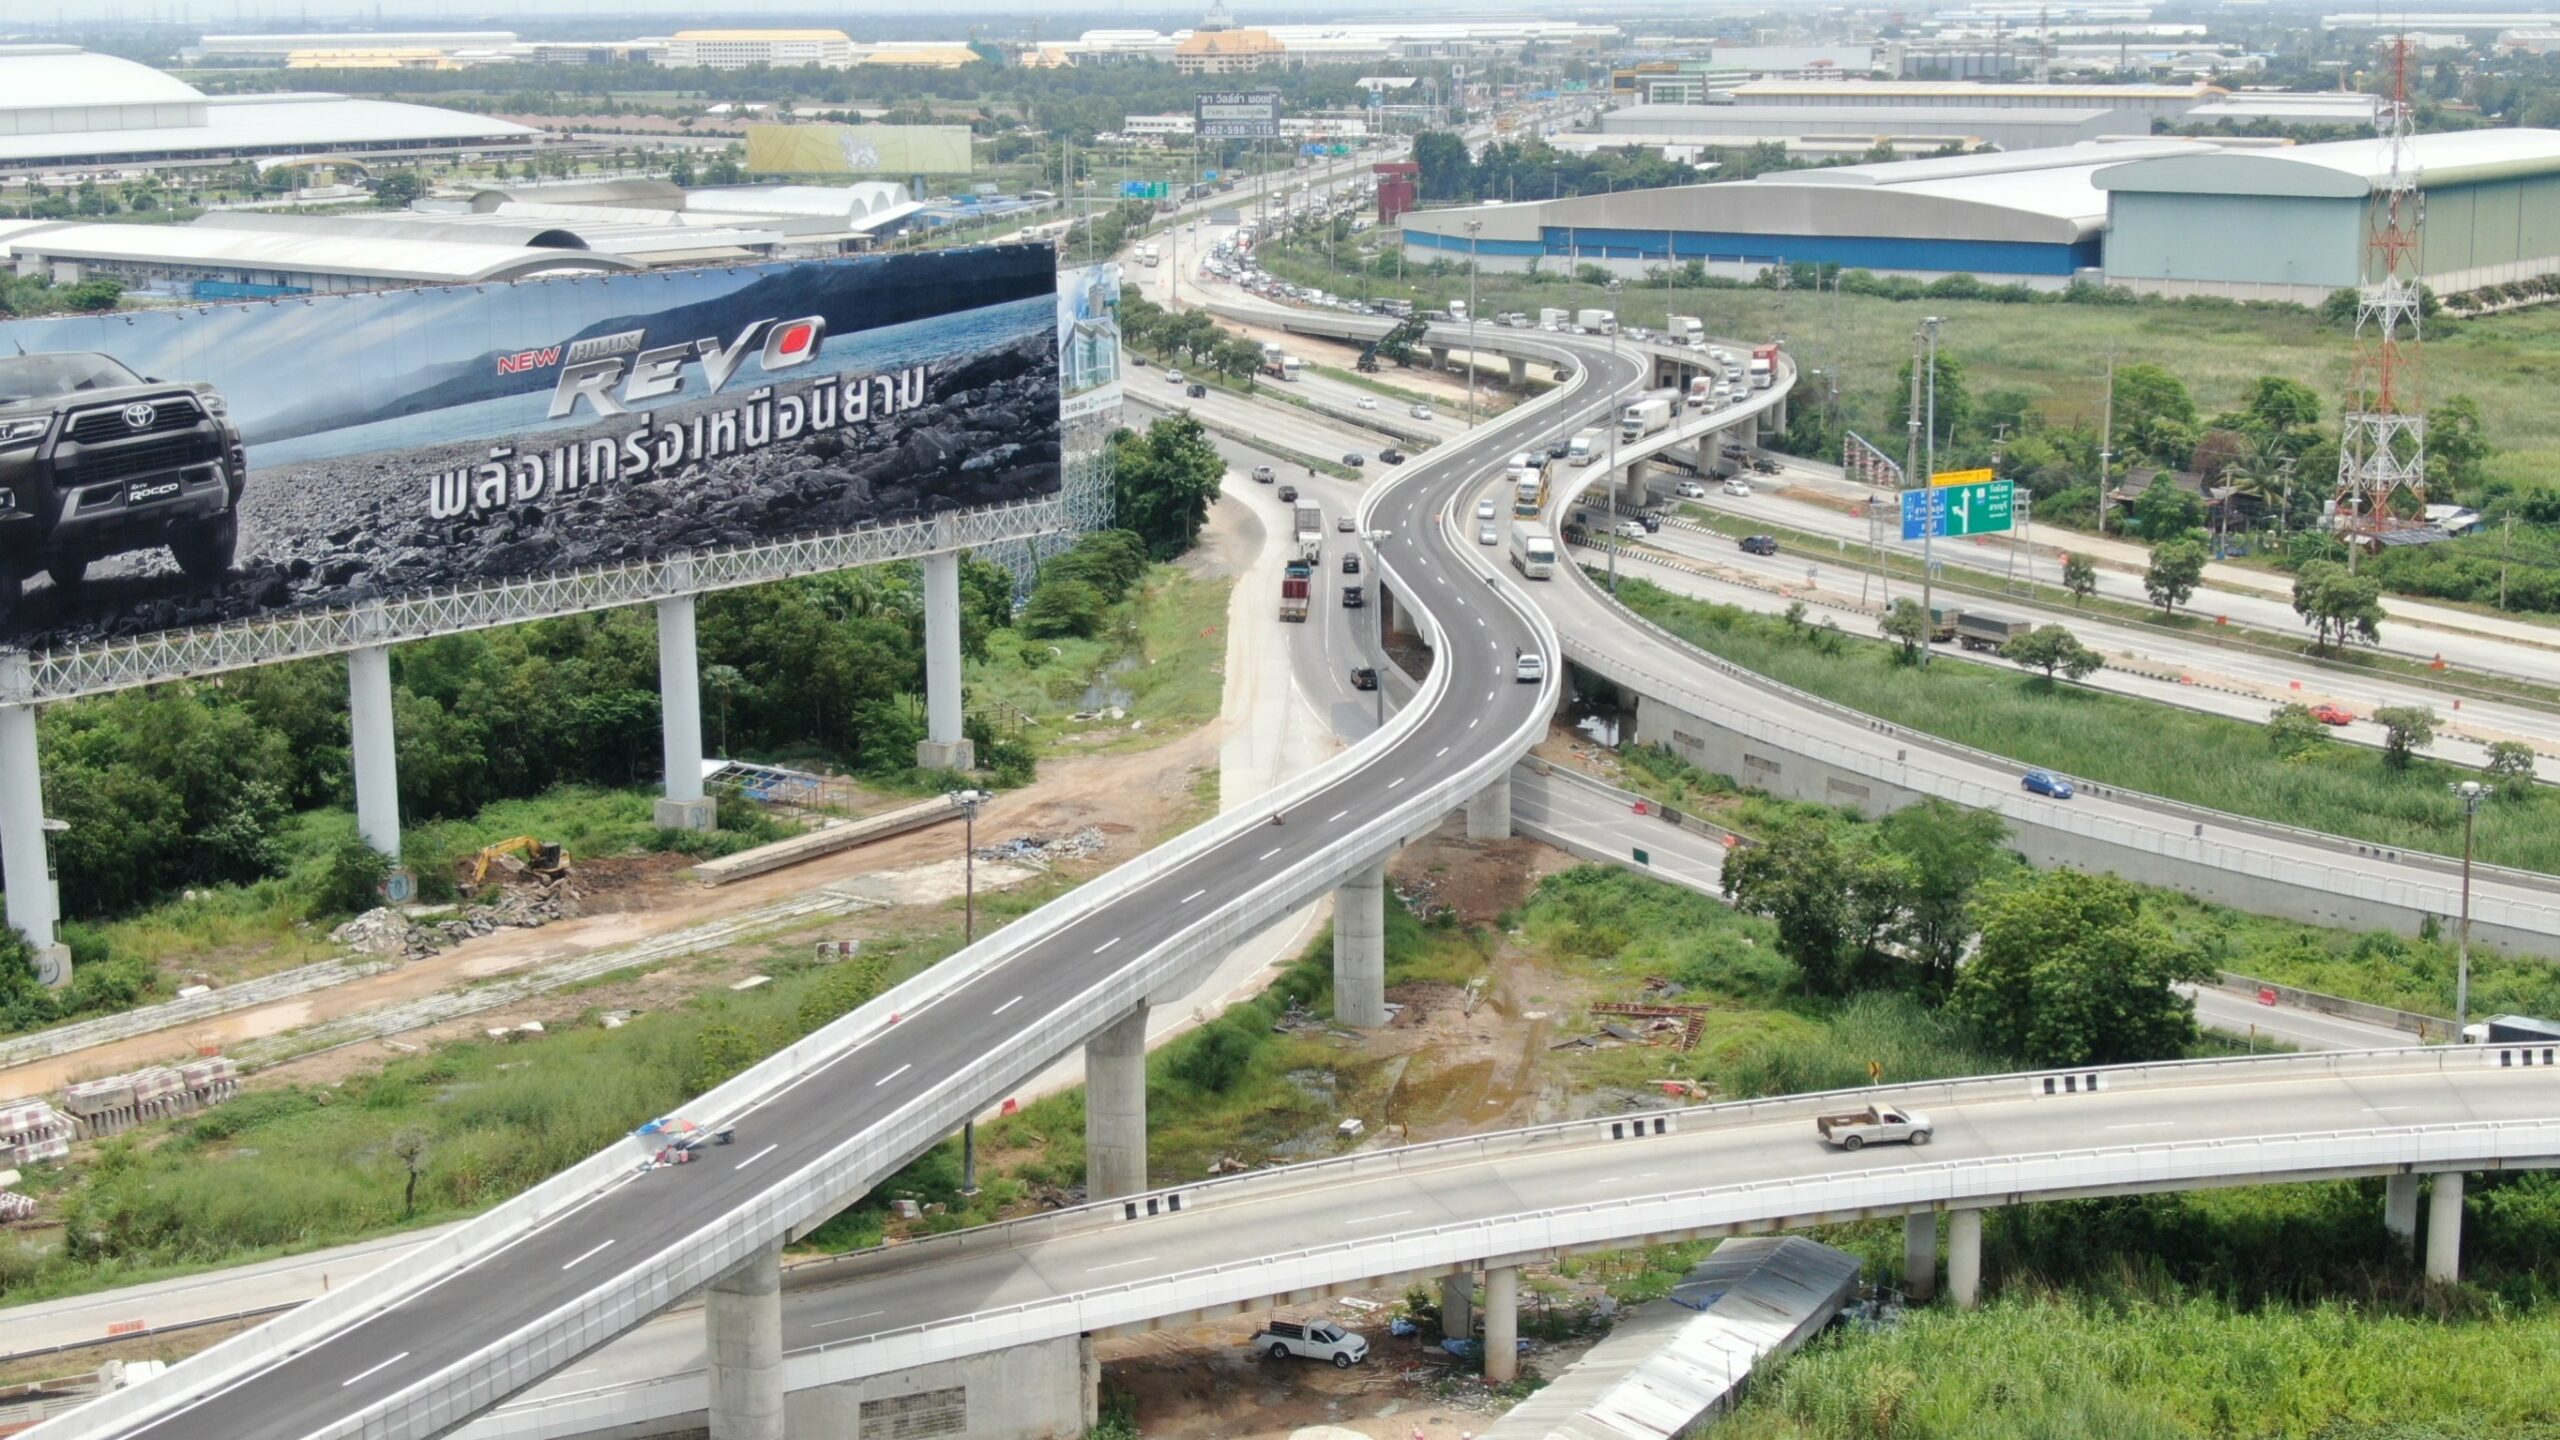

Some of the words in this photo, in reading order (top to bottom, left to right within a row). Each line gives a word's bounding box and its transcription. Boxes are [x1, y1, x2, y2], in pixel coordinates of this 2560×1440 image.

[498, 345, 561, 375] NEW
[572, 332, 641, 361] HILUX
[547, 315, 826, 418] REVO
[430, 364, 927, 520] พลังแกร่งเหนือนิยาม
[129, 483, 179, 502] ROCCO
